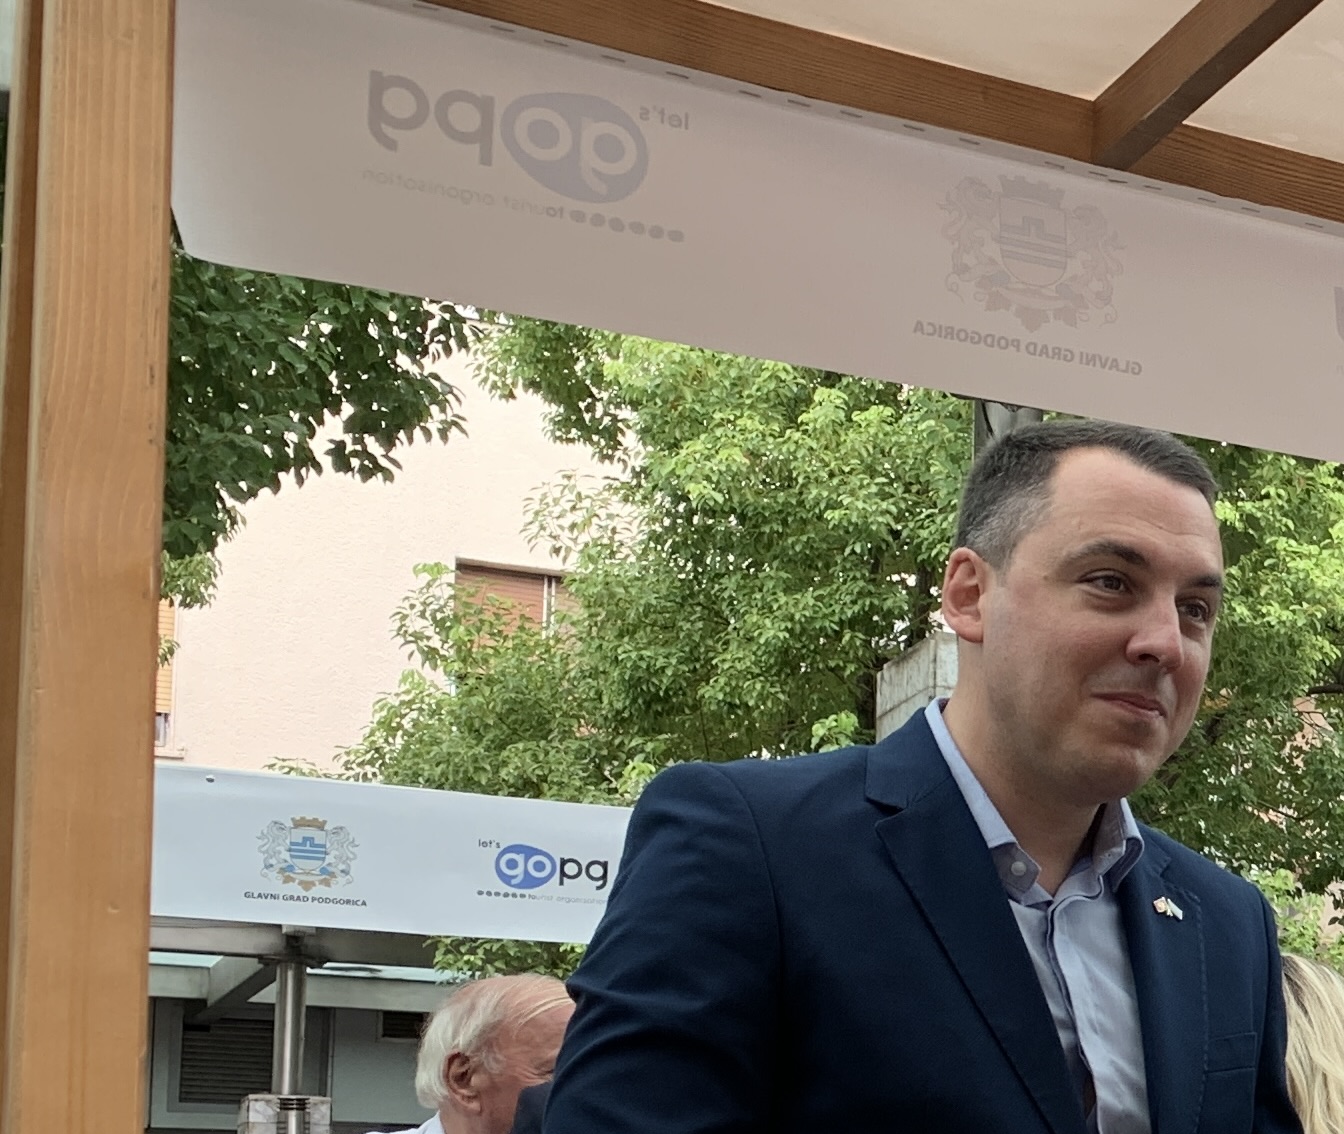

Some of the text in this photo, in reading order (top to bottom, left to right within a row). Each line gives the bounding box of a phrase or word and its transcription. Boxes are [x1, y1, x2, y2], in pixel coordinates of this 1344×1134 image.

[478, 839, 500, 848] let's
[244, 891, 367, 907] GLAVNI GRAD PODGORICA
